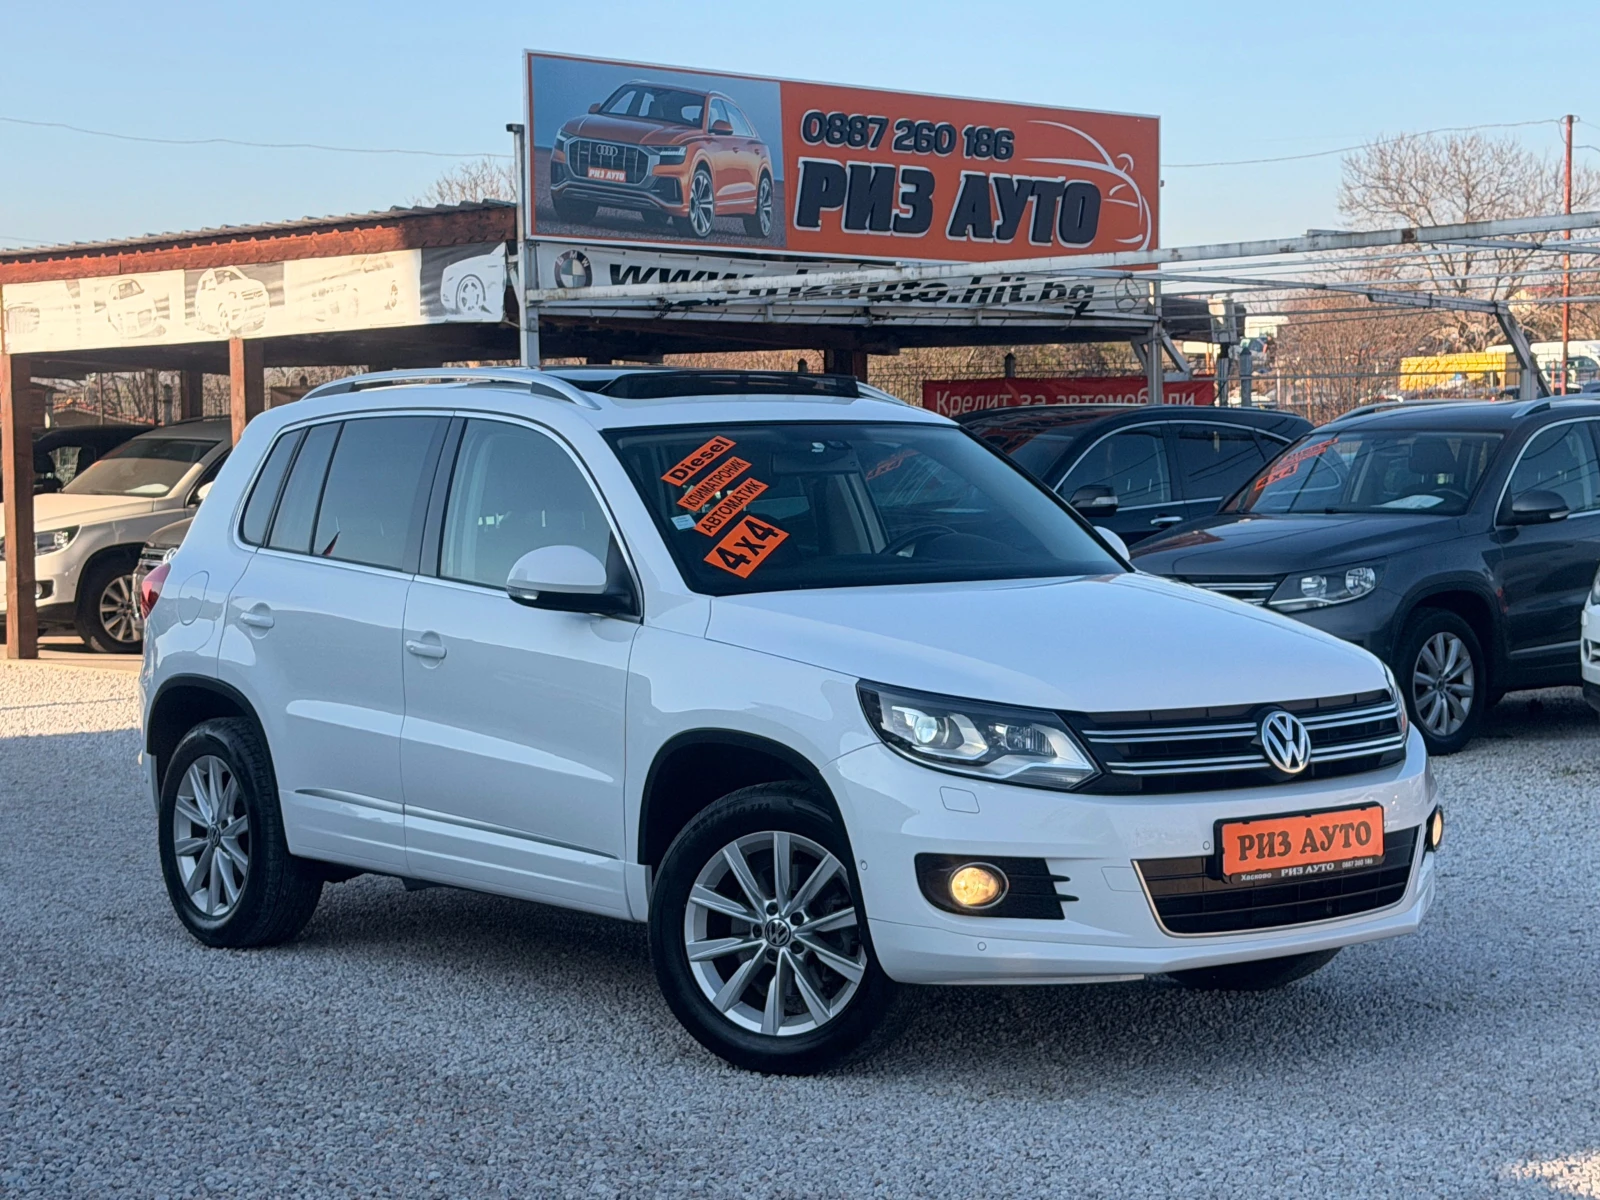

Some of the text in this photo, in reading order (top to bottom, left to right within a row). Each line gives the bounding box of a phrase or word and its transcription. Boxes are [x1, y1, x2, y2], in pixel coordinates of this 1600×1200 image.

[801, 110, 1016, 161] 0887 260 186
[794, 157, 1102, 248] РИЗ АУТО
[935, 389, 1015, 416] Кредит
[1056, 386, 1196, 407] автомобли
[669, 438, 730, 481] Diesel
[683, 459, 746, 507] КЛИМАТРОНИК
[701, 481, 762, 533] АВТОМАТИК
[1237, 821, 1372, 861] РИЗ АУТО
[1240, 872, 1272, 882] Хасково
[1281, 863, 1335, 877] РИЗ АУТО
